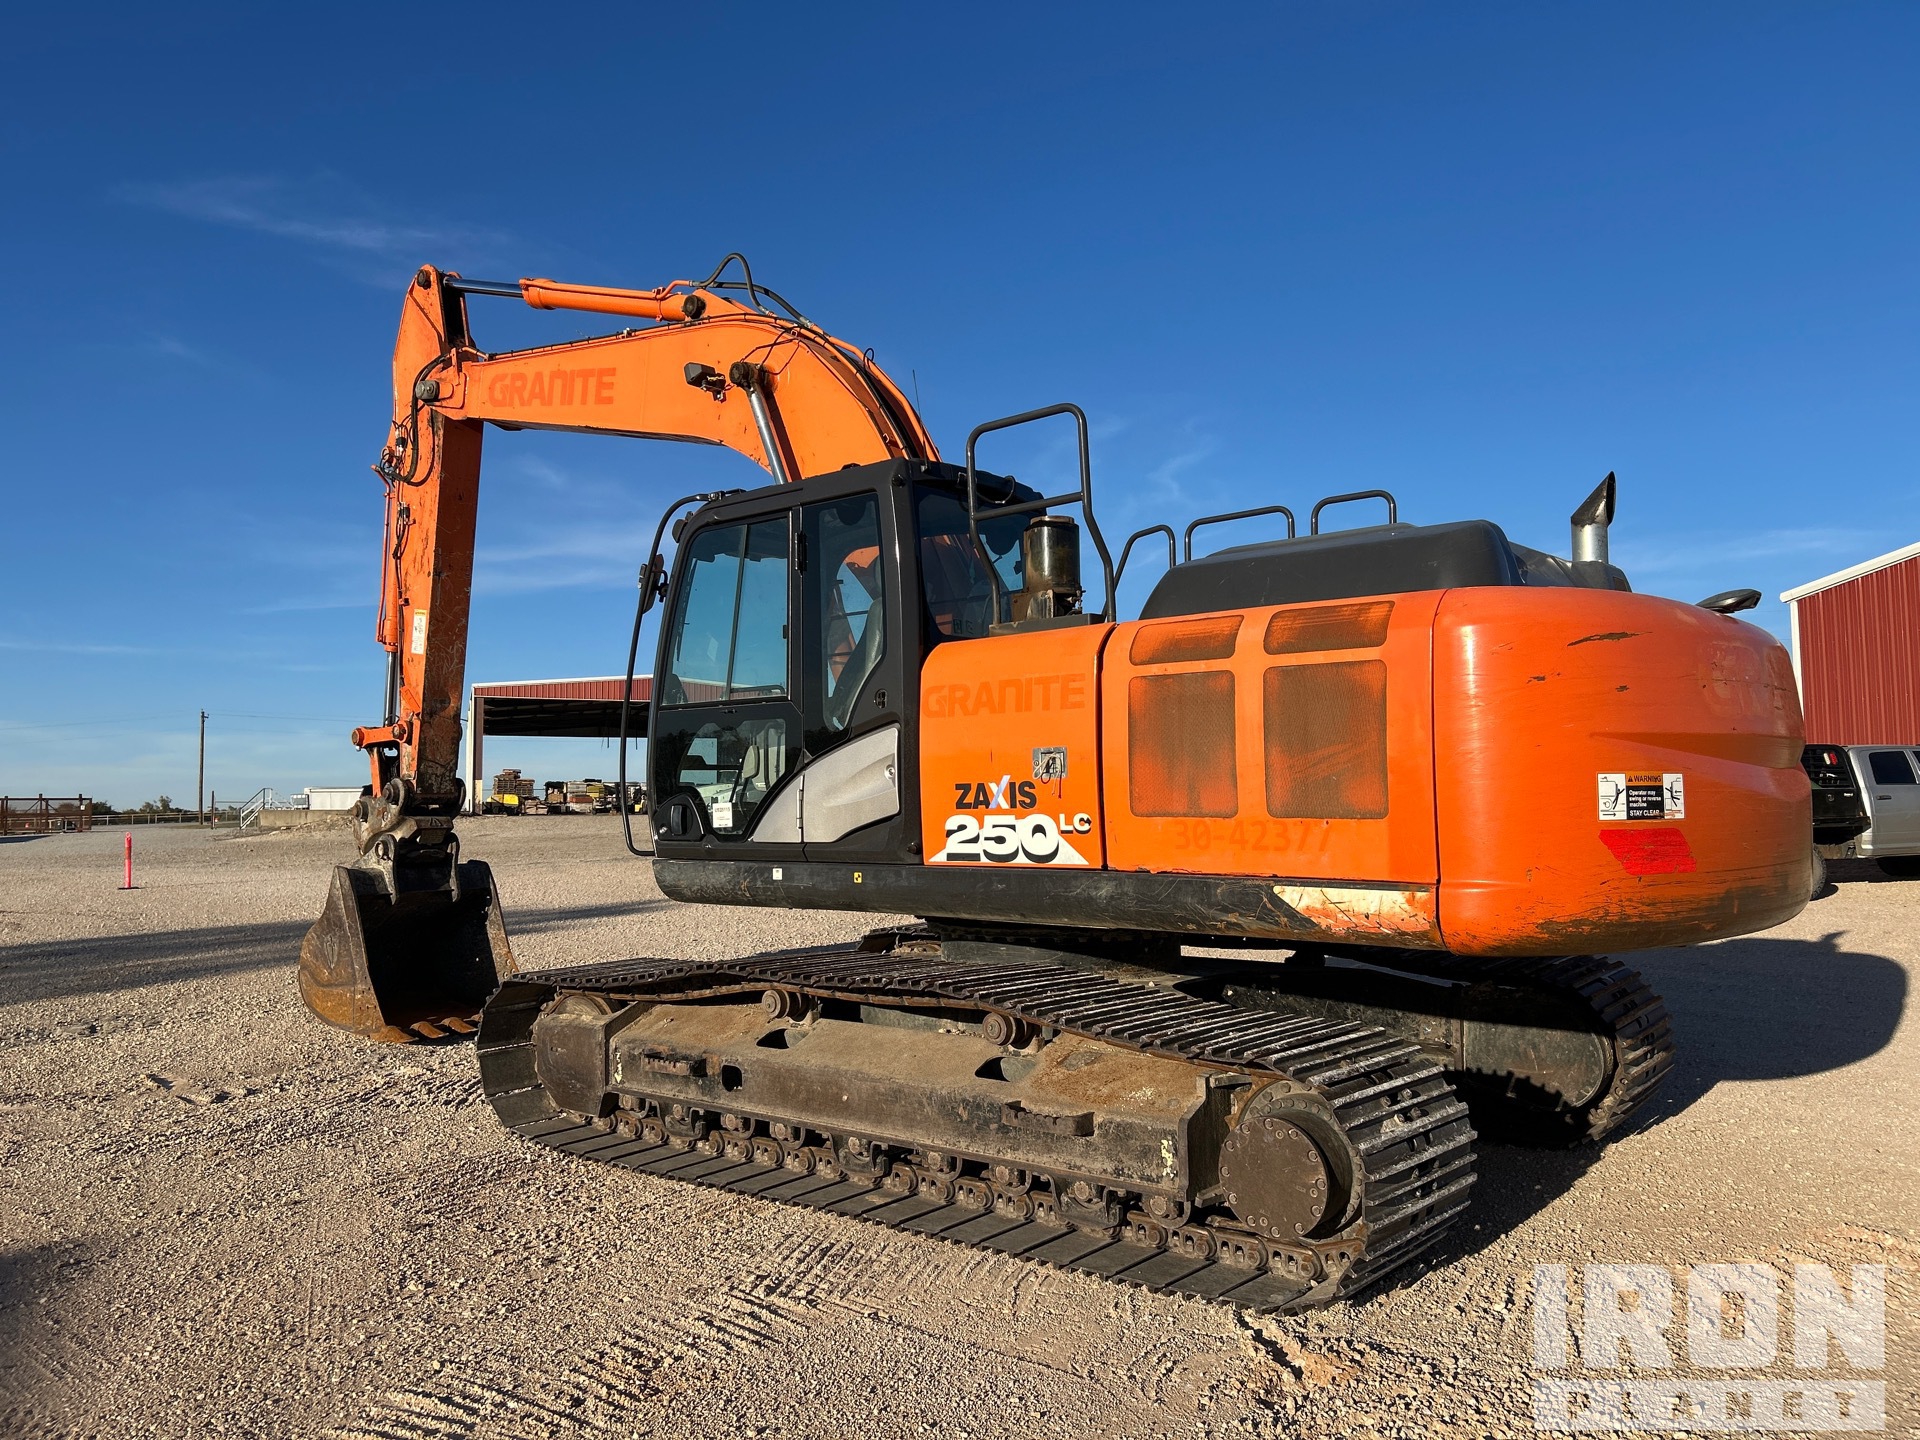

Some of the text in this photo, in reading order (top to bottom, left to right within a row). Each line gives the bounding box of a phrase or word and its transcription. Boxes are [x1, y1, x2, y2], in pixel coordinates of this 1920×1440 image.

[488, 367, 617, 408] GRANITE
[921, 673, 1086, 719] GRANITE
[954, 774, 1038, 810] ZAXIS
[1174, 819, 1333, 853] 30-42377
